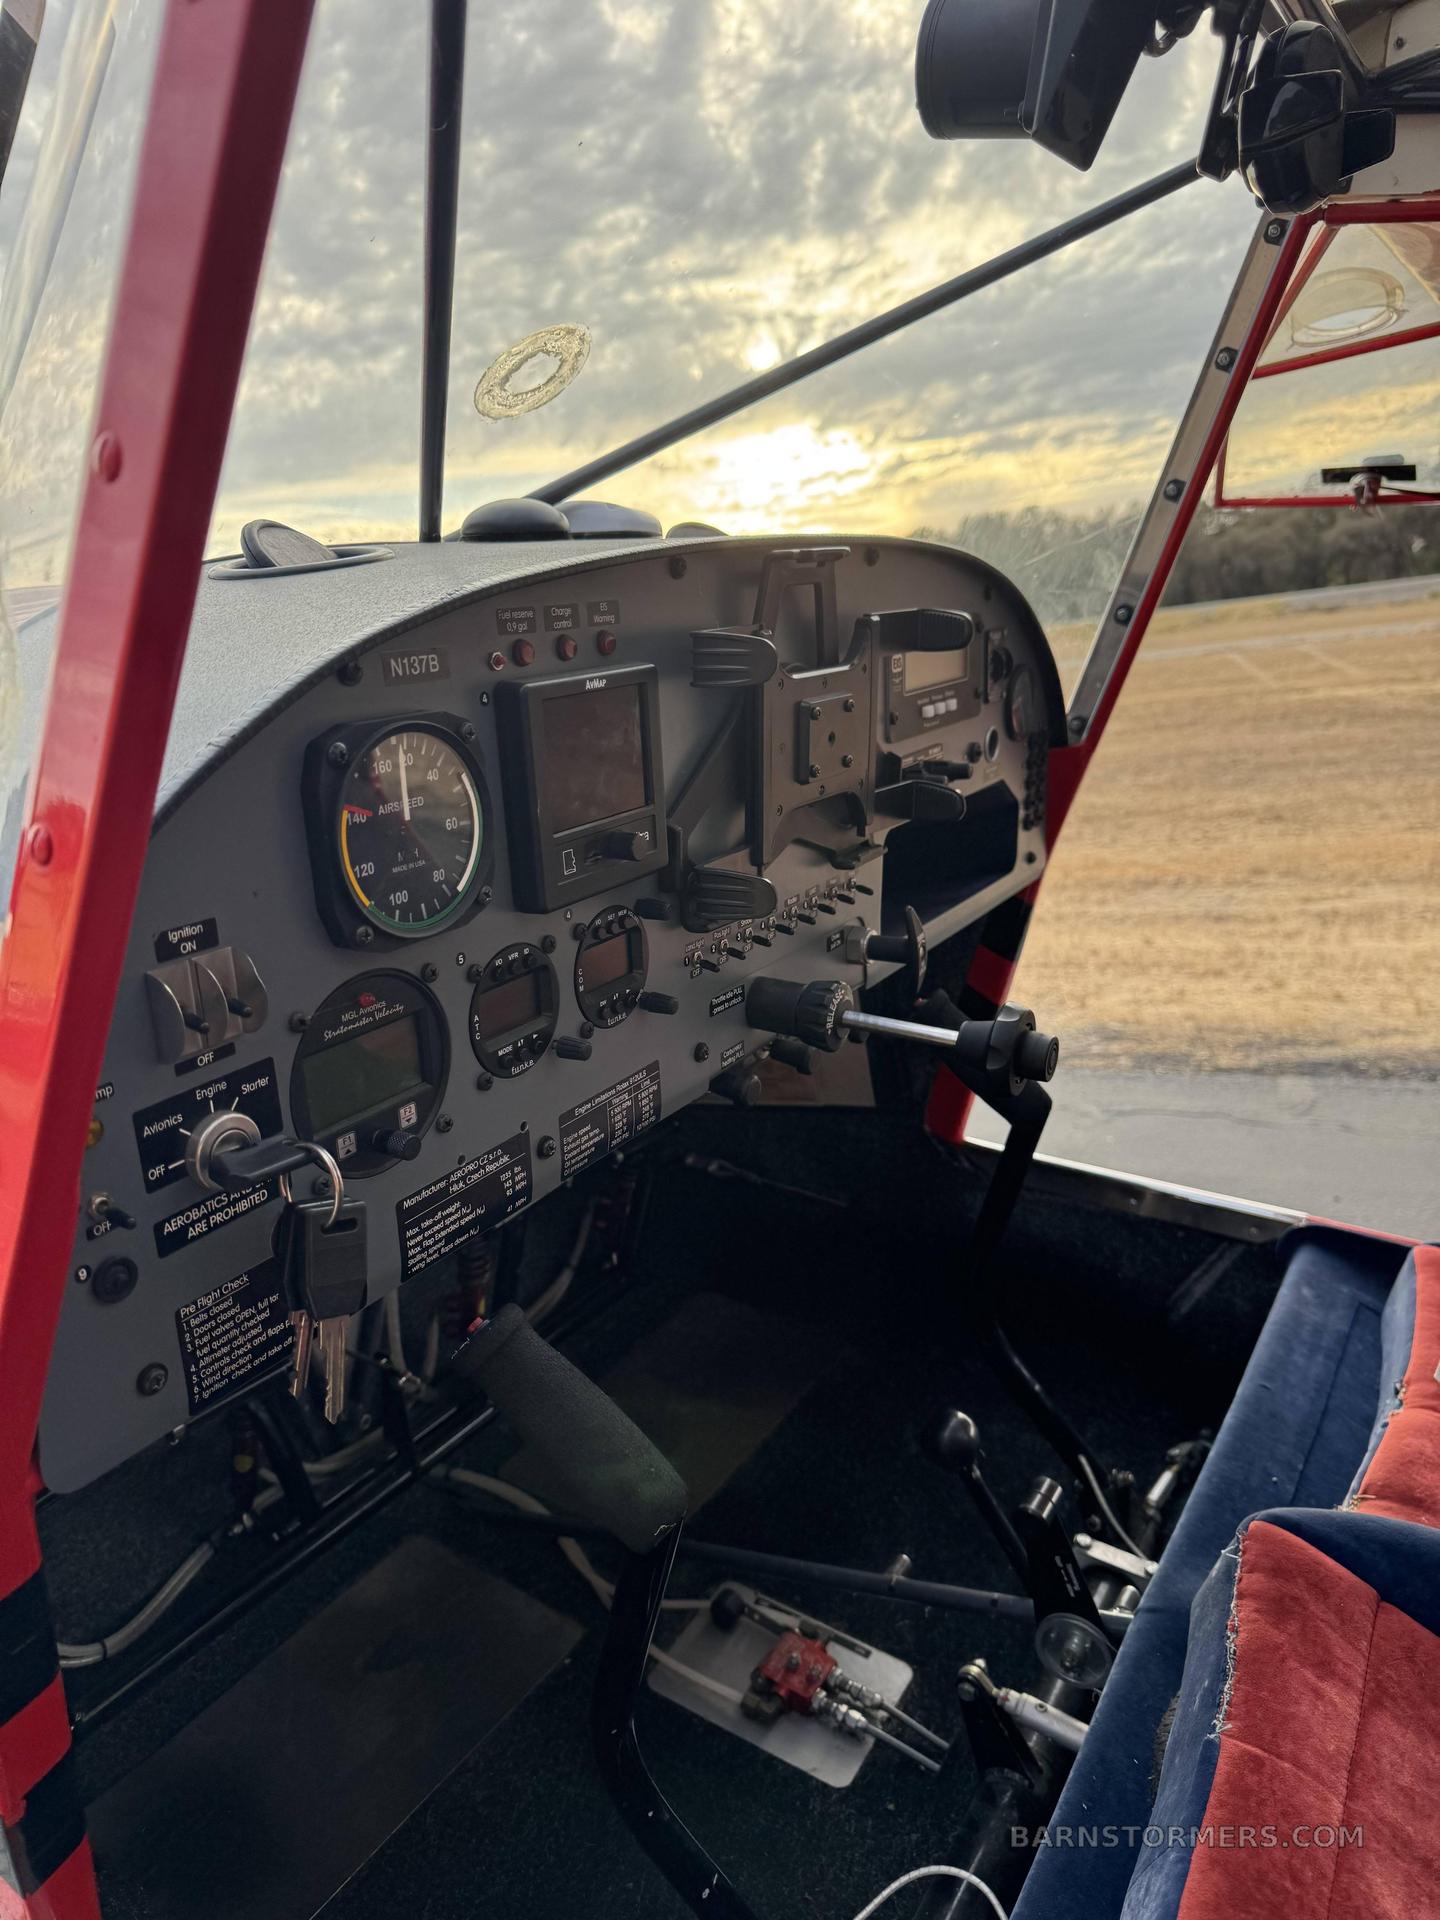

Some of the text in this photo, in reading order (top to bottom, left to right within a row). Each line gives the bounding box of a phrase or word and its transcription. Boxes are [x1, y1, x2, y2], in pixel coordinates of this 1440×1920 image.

[390, 653, 440, 678] N137B
[372, 761, 393, 775] 160
[426, 768, 440, 782] 40
[445, 817, 459, 831] 60
[353, 862, 376, 879] 120
[432, 868, 446, 883] 80
[388, 889, 409, 906] 100
[167, 923, 204, 943] Ignition
[180, 940, 197, 955] ON
[508, 951, 519, 961] VFR
[458, 954, 464, 964] 5
[692, 967, 701, 977] OFF
[341, 1000, 387, 1024] MGL Avionics
[323, 1003, 405, 1042] Stratomaster Velocity
[196, 1051, 215, 1068] OFF
[497, 1044, 513, 1057] MODE
[95, 1086, 113, 1100] mp
[195, 1080, 228, 1101] Engine
[240, 1075, 270, 1095] Starter
[402, 1107, 413, 1116] F2
[143, 1112, 184, 1139] Avionics
[342, 1135, 353, 1146] F1
[148, 1163, 167, 1182] OFF
[465, 1169, 486, 1185] Czech
[485, 1153, 511, 1174] Republic
[402, 1179, 450, 1211] Manufacturer:
[448, 1160, 480, 1184] AEROPRO
[479, 1155, 489, 1166] CZ
[162, 1192, 229, 1237] AEROBATICS
[186, 1188, 269, 1241] ARE PROHIBITED
[78, 1268, 88, 1282] 9
[179, 1272, 250, 1320] Pre Flight Check
[182, 1296, 234, 1332] 1. Belts closed
[184, 1302, 242, 1343] 2. Doors closed
[194, 1330, 213, 1348] Fuel
[211, 1318, 236, 1342] valves
[257, 1297, 270, 1312] full
[196, 1342, 212, 1359] fuel
[211, 1327, 241, 1354] quantity
[240, 1308, 271, 1333] checked
[198, 1343, 232, 1370] Altimeter
[231, 1324, 264, 1350] adjusted
[199, 1354, 231, 1379] Controls
[230, 1342, 253, 1361] check
[252, 1333, 268, 1346] and
[267, 1321, 286, 1339] flaps
[201, 1378, 230, 1400] Ignition
[230, 1362, 253, 1381] check
[252, 1355, 268, 1368] and
[267, 1342, 284, 1359] take
[201, 1372, 222, 1391] Wind
[221, 1352, 254, 1378] direction
